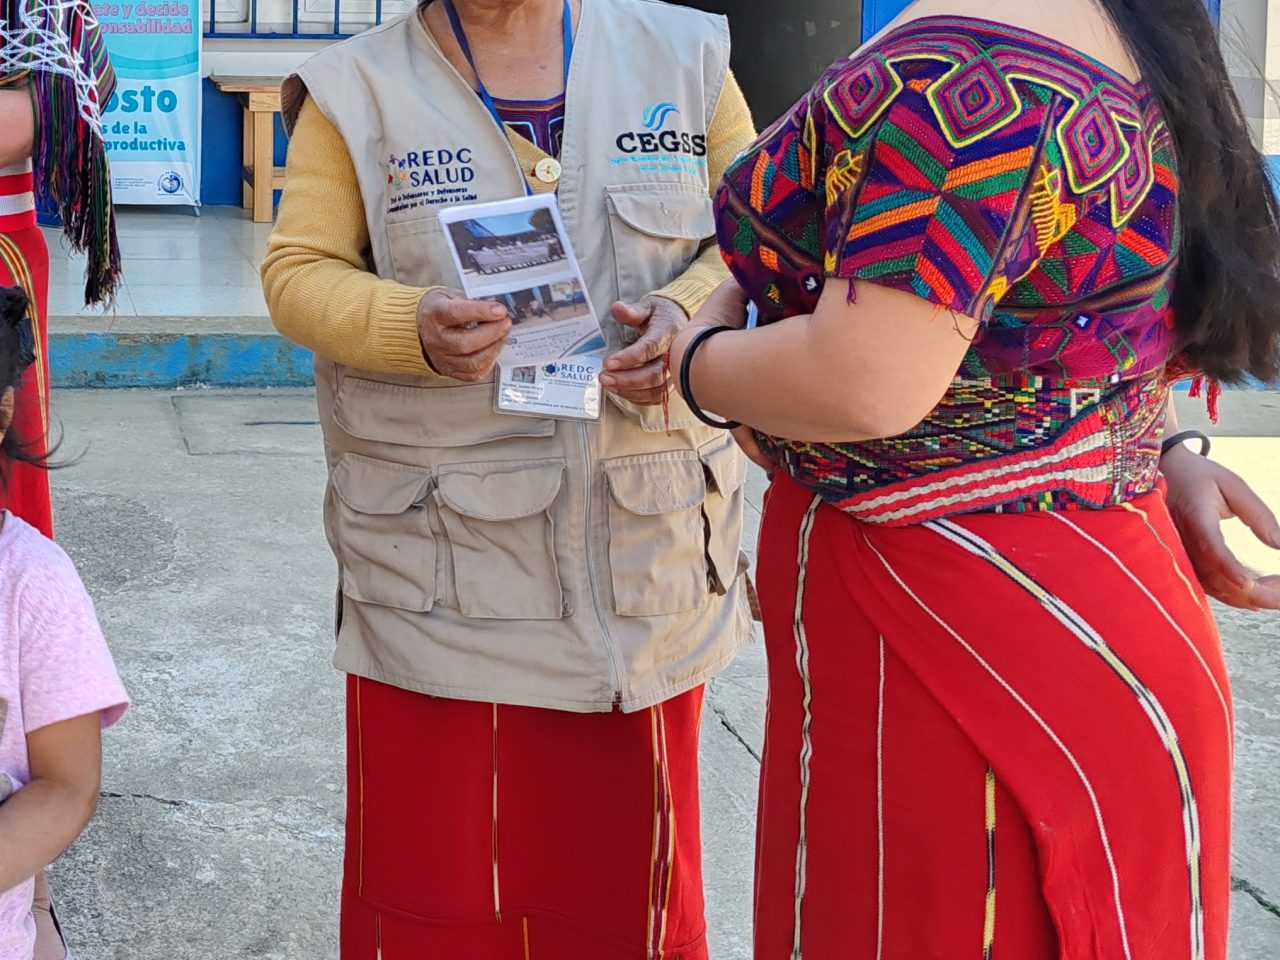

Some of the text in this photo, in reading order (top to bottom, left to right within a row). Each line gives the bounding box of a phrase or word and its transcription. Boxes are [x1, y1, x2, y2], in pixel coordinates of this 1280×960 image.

[122, 5, 132, 19] y
[136, 1, 188, 16] decide
[111, 121, 130, 135] de
[134, 121, 148, 135] la
[616, 130, 707, 156] CEGSS
[407, 147, 473, 169] REDC
[410, 166, 475, 188] SALUD
[560, 372, 594, 382] SALUD
[561, 363, 594, 374] REDC
